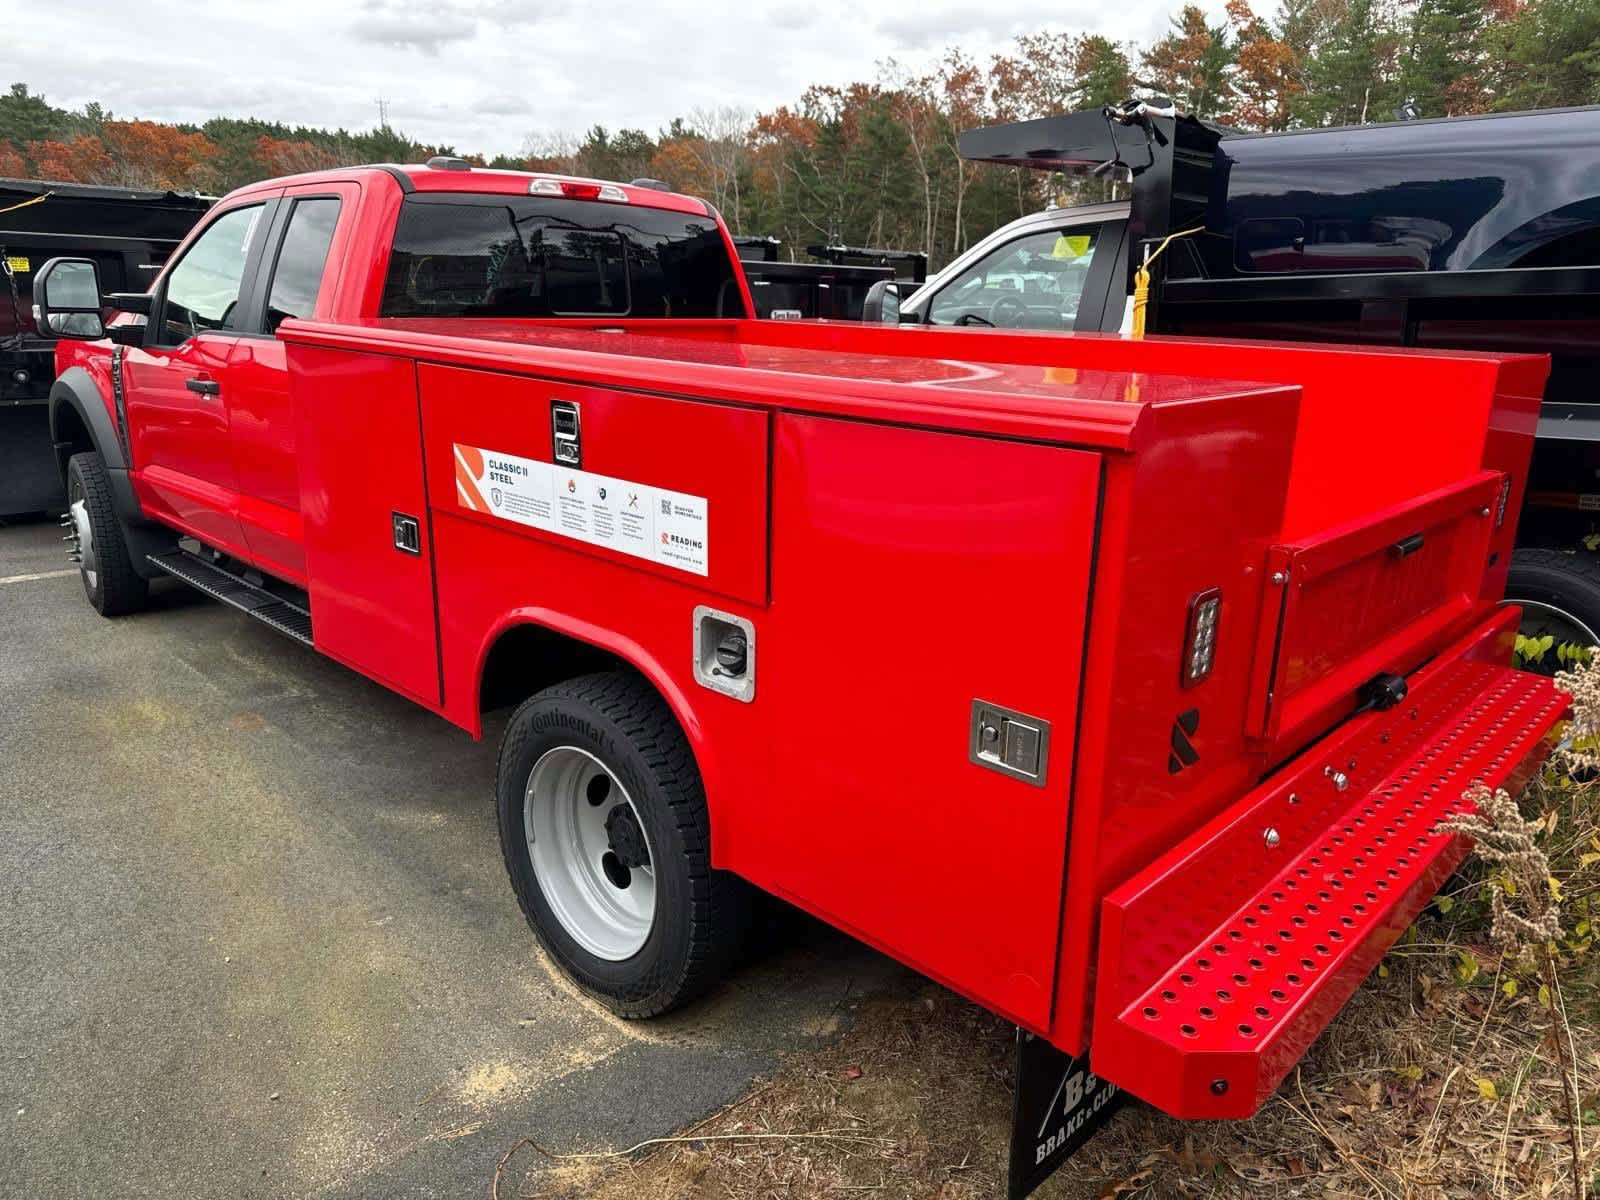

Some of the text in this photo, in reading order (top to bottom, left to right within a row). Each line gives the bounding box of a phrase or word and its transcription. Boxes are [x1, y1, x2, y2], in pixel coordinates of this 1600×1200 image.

[489, 459, 522, 475] CLASSIC
[489, 471, 514, 485] STEEL
[670, 534, 703, 549] READING
[531, 707, 606, 745] Continental
[1035, 1108, 1085, 1166] BRAKE
[1093, 1083, 1120, 1113] CLU
